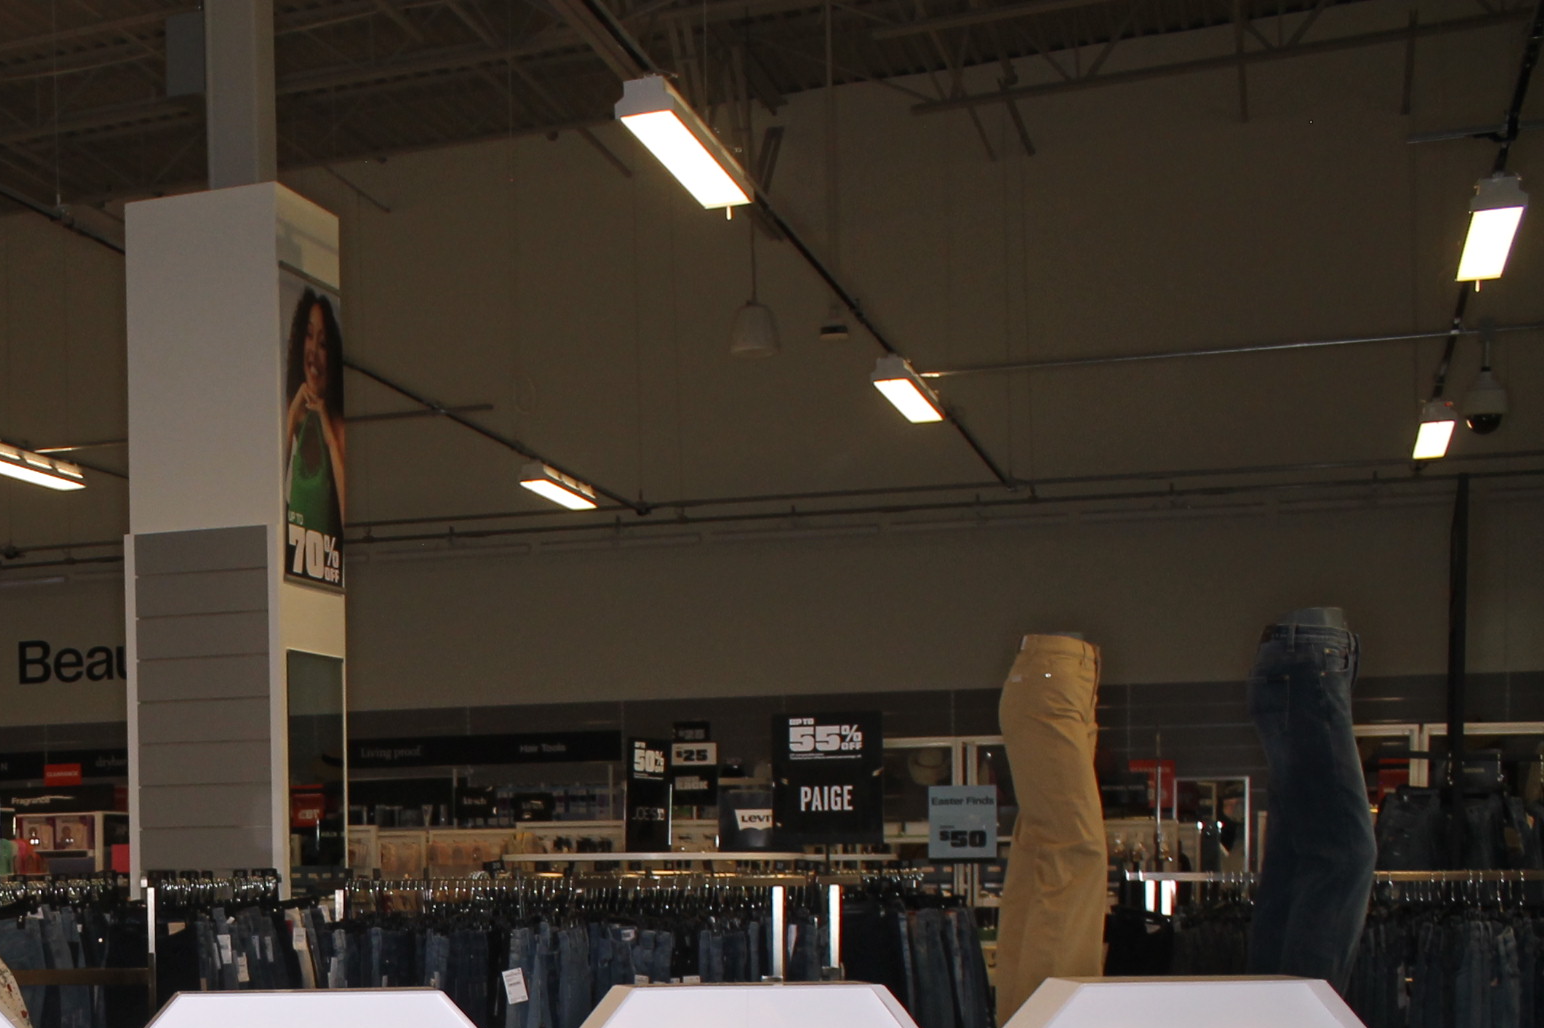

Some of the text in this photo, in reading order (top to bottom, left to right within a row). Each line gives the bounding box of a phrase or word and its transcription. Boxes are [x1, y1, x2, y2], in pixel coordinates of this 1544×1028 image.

[288, 523, 340, 579] 70%
[789, 724, 863, 752] 55%
[840, 741, 863, 751] OFF
[800, 785, 854, 812] PAIGE
[939, 830, 987, 848] $50
